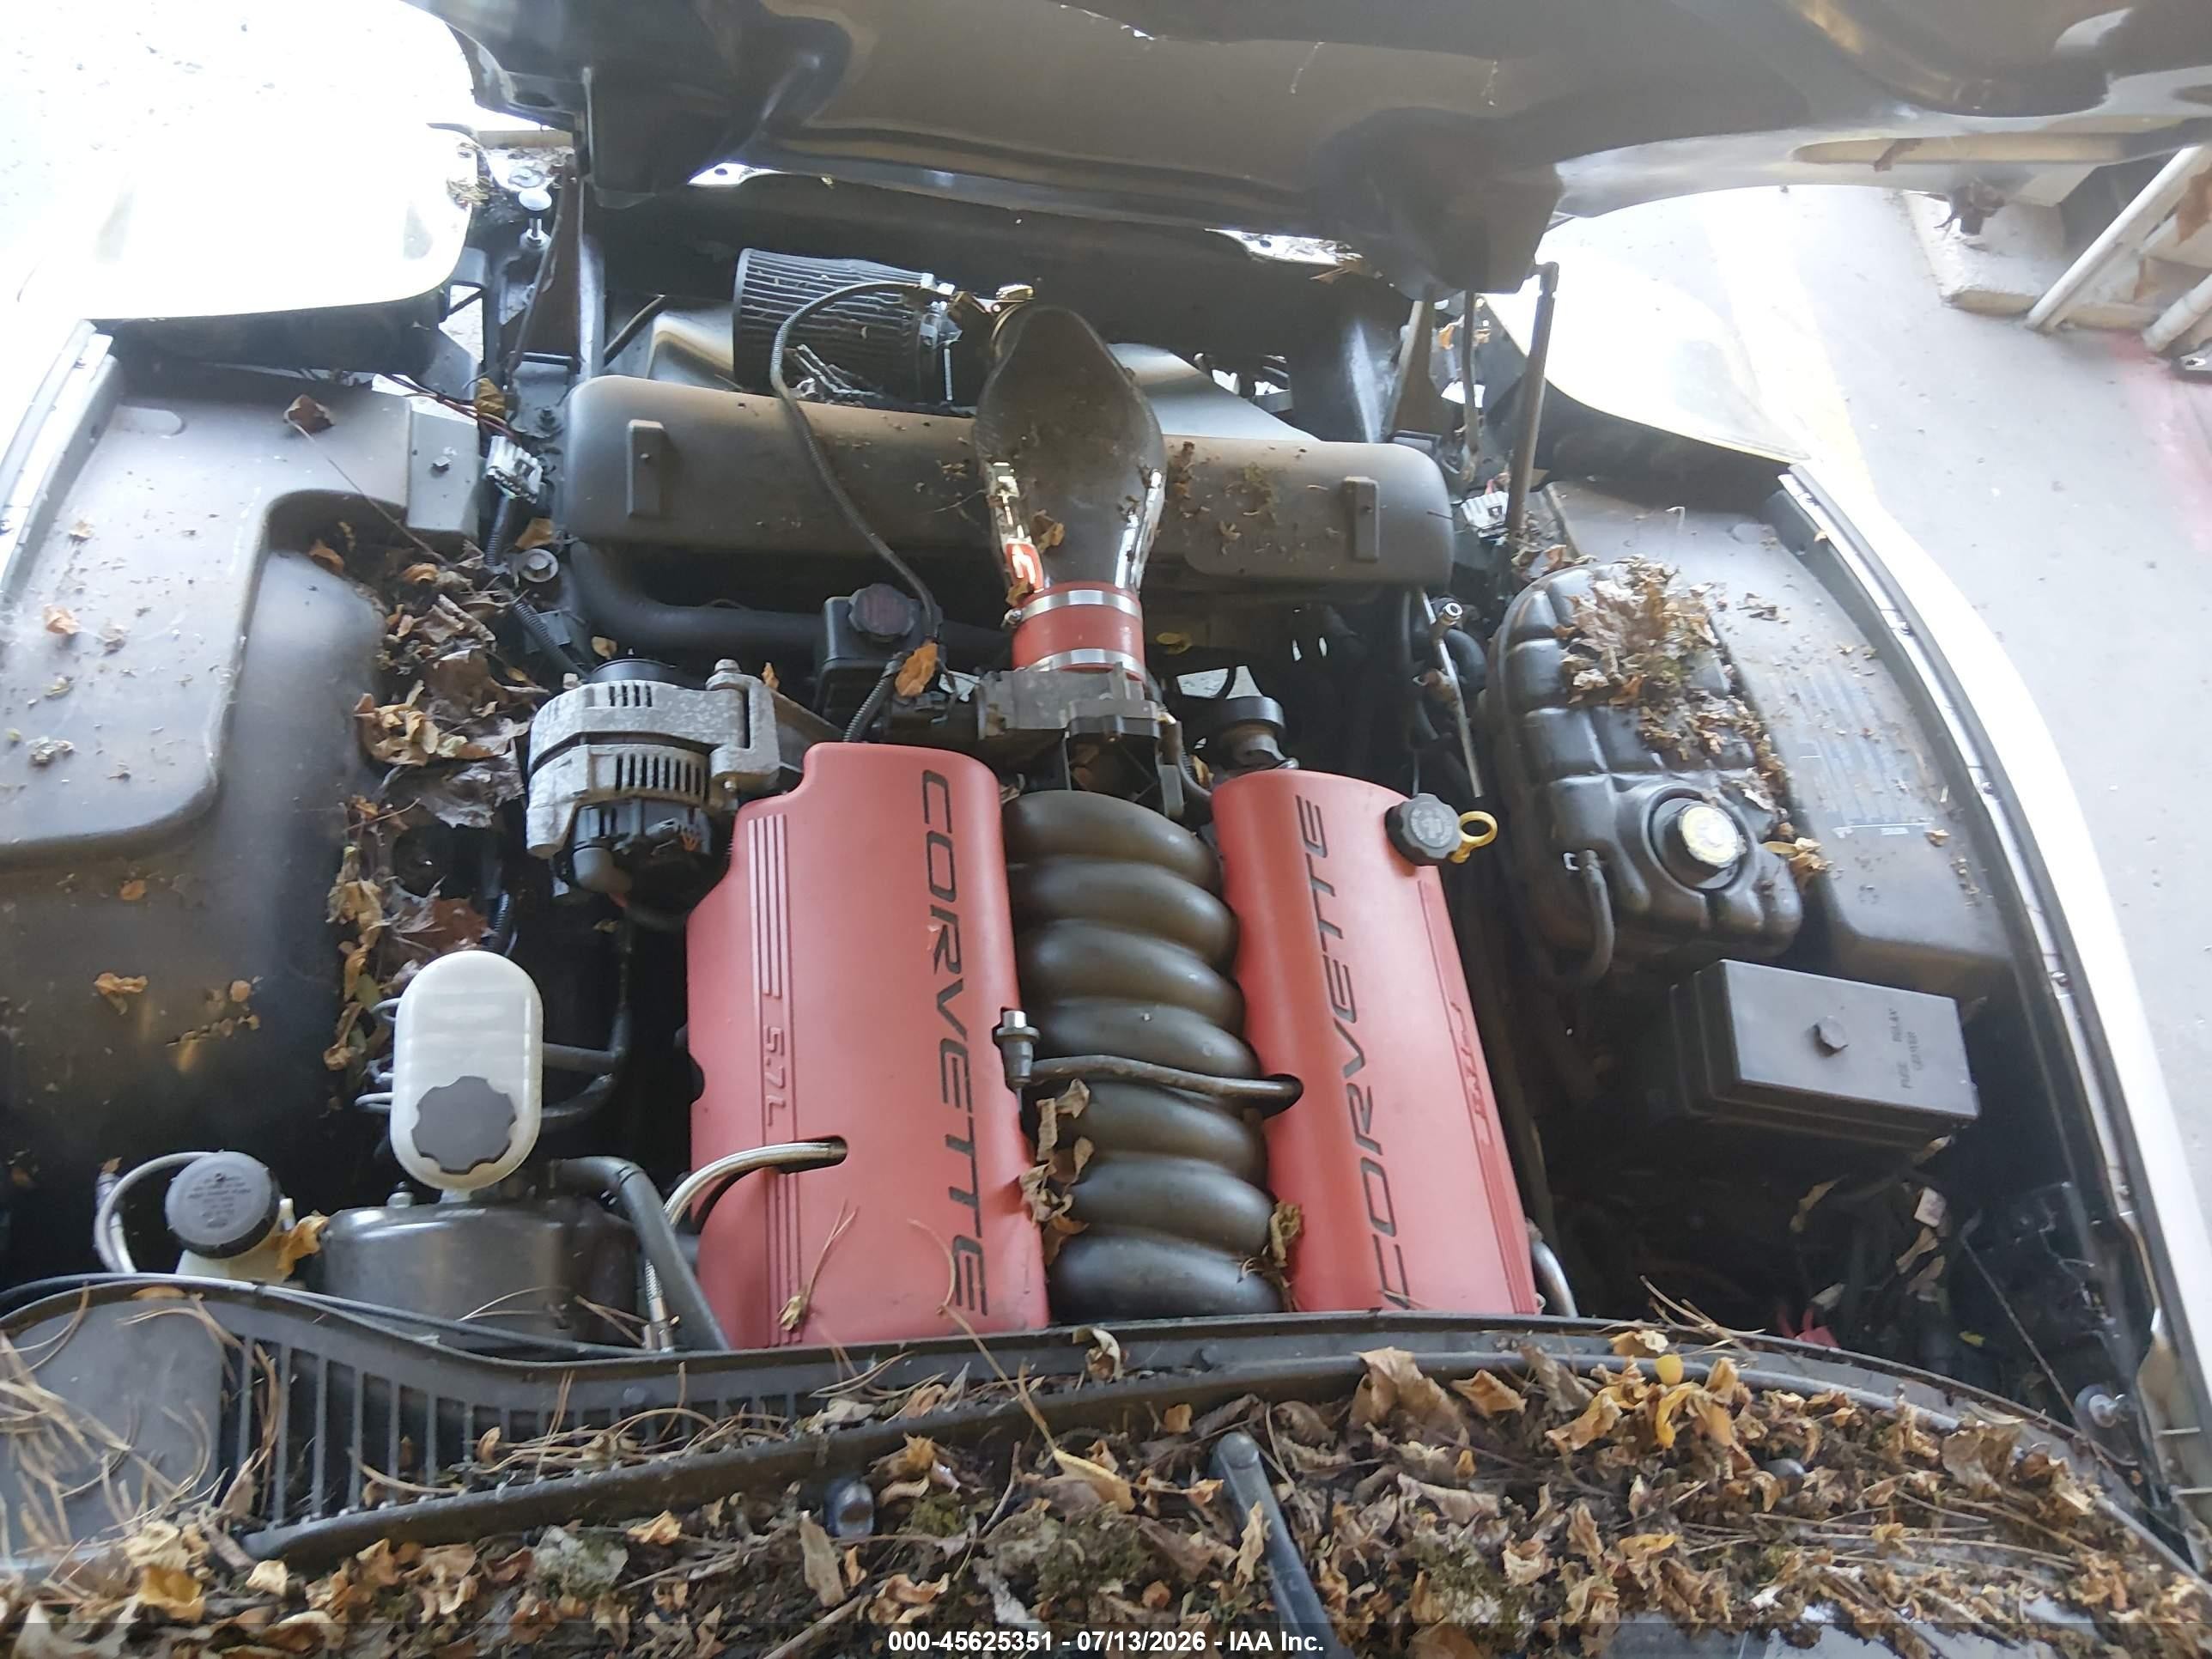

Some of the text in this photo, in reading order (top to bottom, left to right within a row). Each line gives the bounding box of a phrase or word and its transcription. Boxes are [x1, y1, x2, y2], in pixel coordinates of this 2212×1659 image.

[763, 1024, 787, 1127] 5.7L
[921, 769, 988, 1317] CORVETTE
[1295, 793, 1411, 1310] CORVETTE
